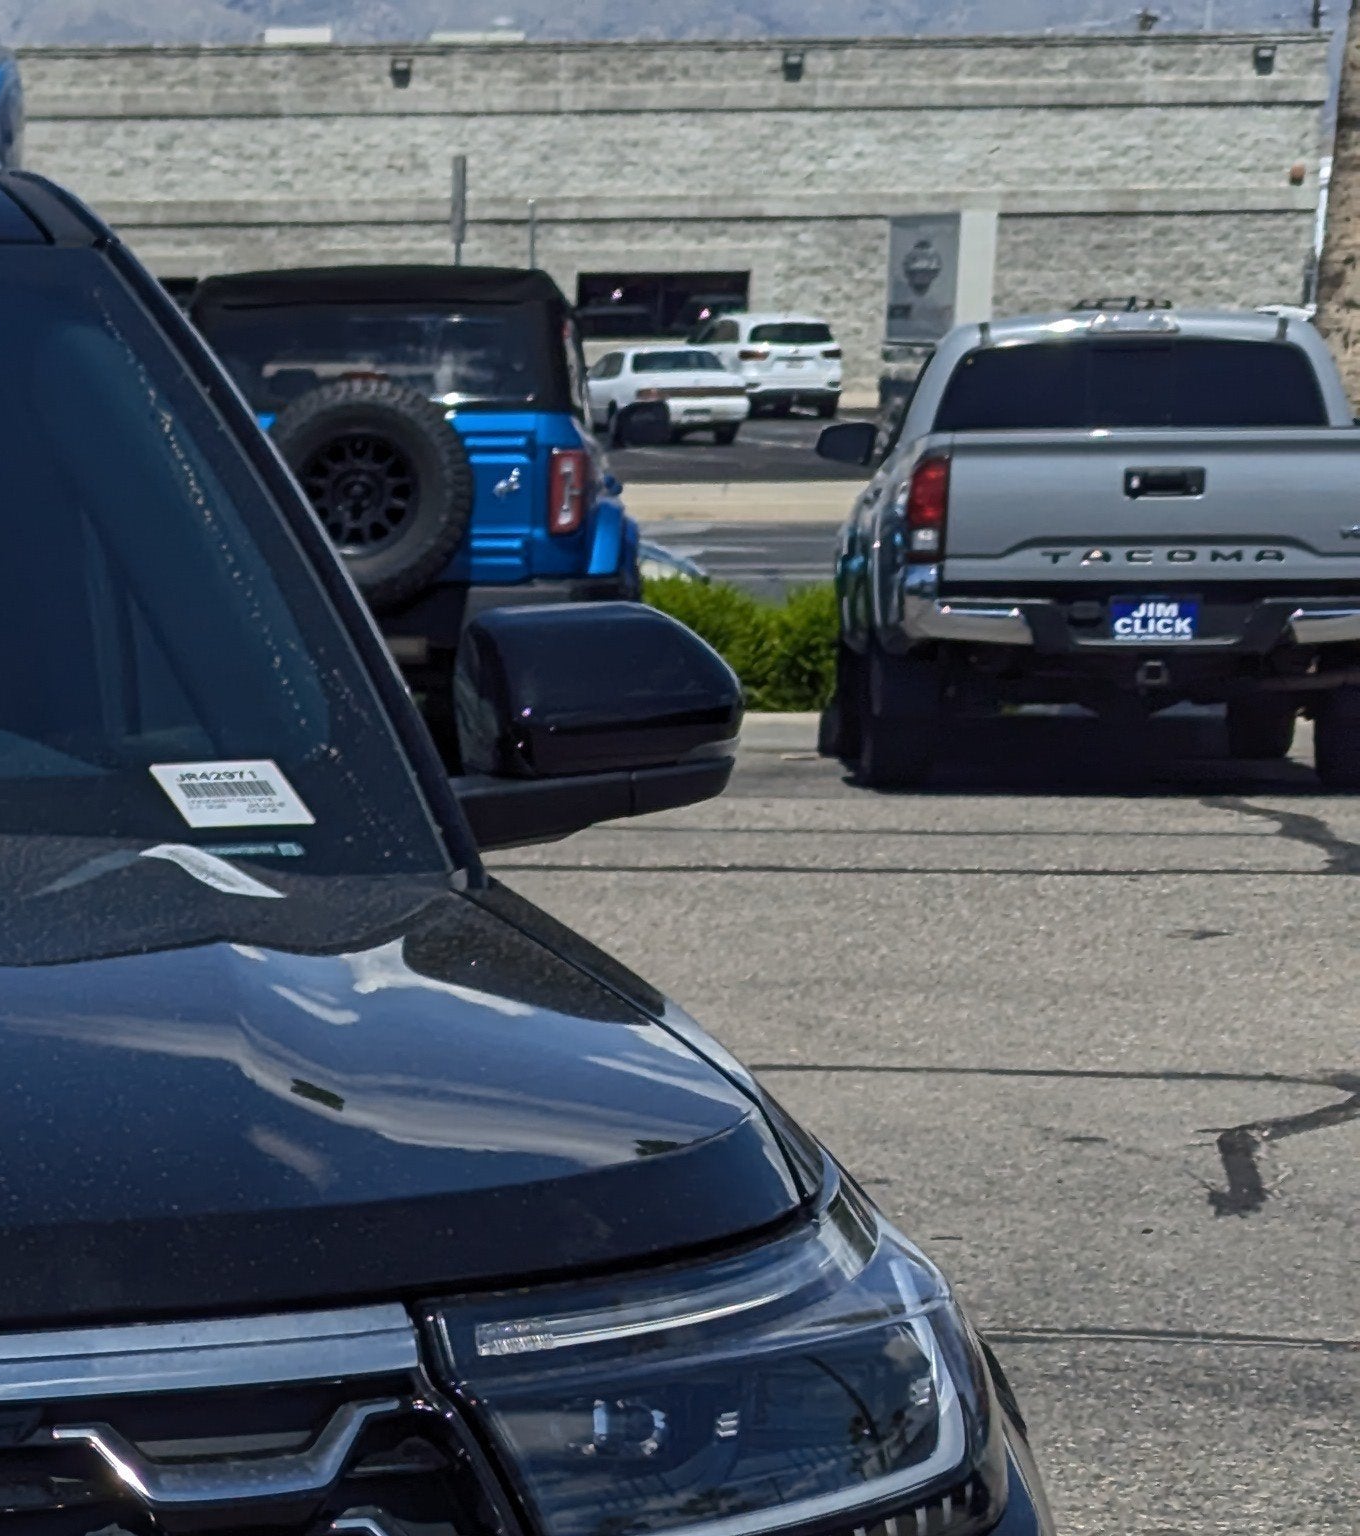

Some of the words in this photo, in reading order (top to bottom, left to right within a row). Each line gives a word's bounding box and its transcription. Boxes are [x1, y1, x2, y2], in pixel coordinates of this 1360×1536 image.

[1041, 549, 1286, 565] TACOMA
[1131, 602, 1179, 619] JIM
[1114, 617, 1193, 635] CLICK
